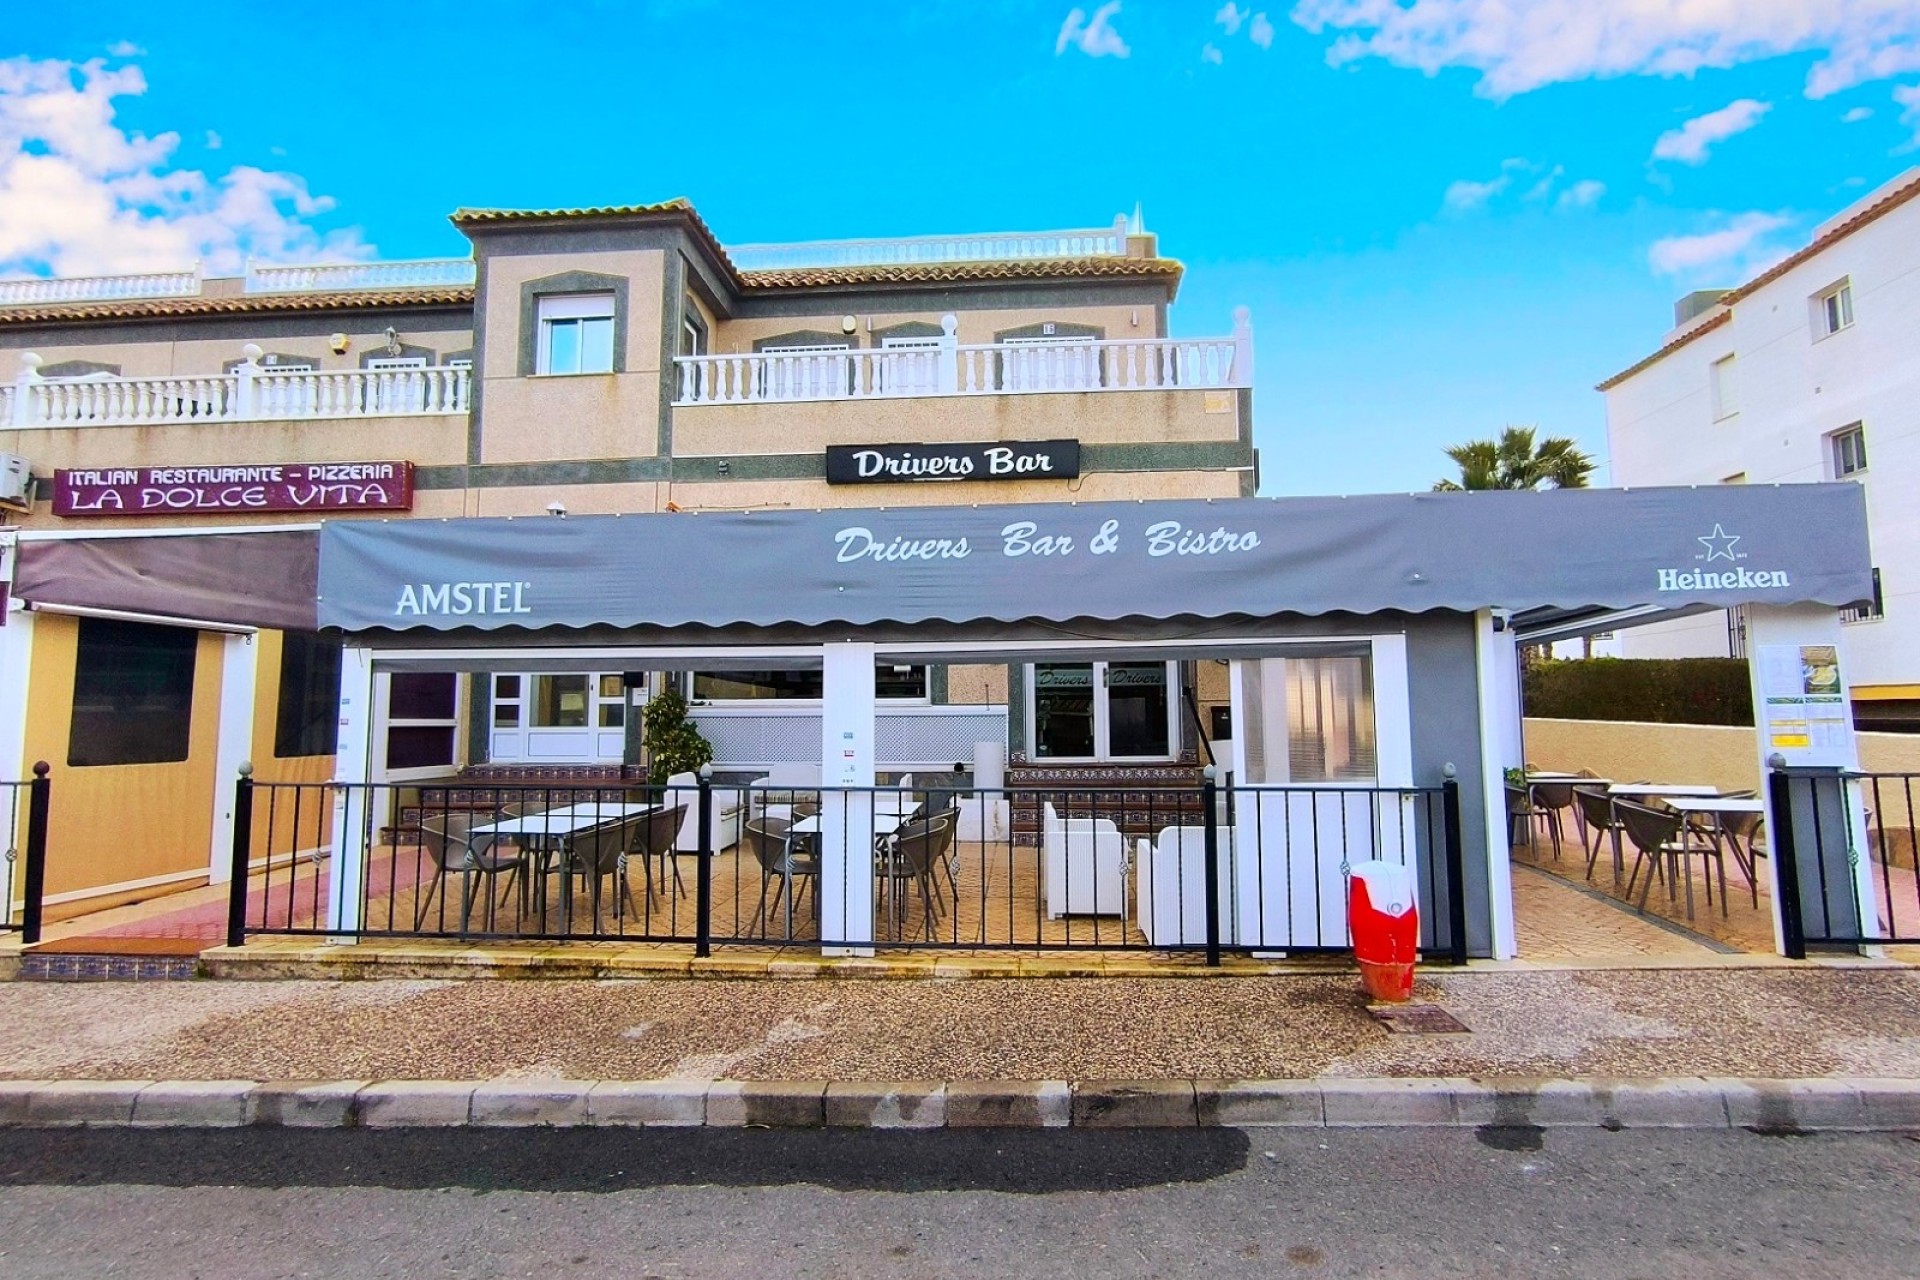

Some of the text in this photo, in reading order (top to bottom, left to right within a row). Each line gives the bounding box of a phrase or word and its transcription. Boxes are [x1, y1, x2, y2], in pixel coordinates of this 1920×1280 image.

[852, 447, 1053, 477] Drivers Bar
[68, 470, 138, 486] ITALIAN
[150, 466, 283, 484] RESTAURANTE
[308, 464, 393, 481] PIZZERIA
[71, 483, 389, 510] LA DOLCE VITA
[834, 519, 1262, 563] Drivers Bar & Bistro
[1657, 566, 1791, 591] Heineken
[1039, 671, 1089, 686] Drivers
[1112, 669, 1161, 684] Drivers
